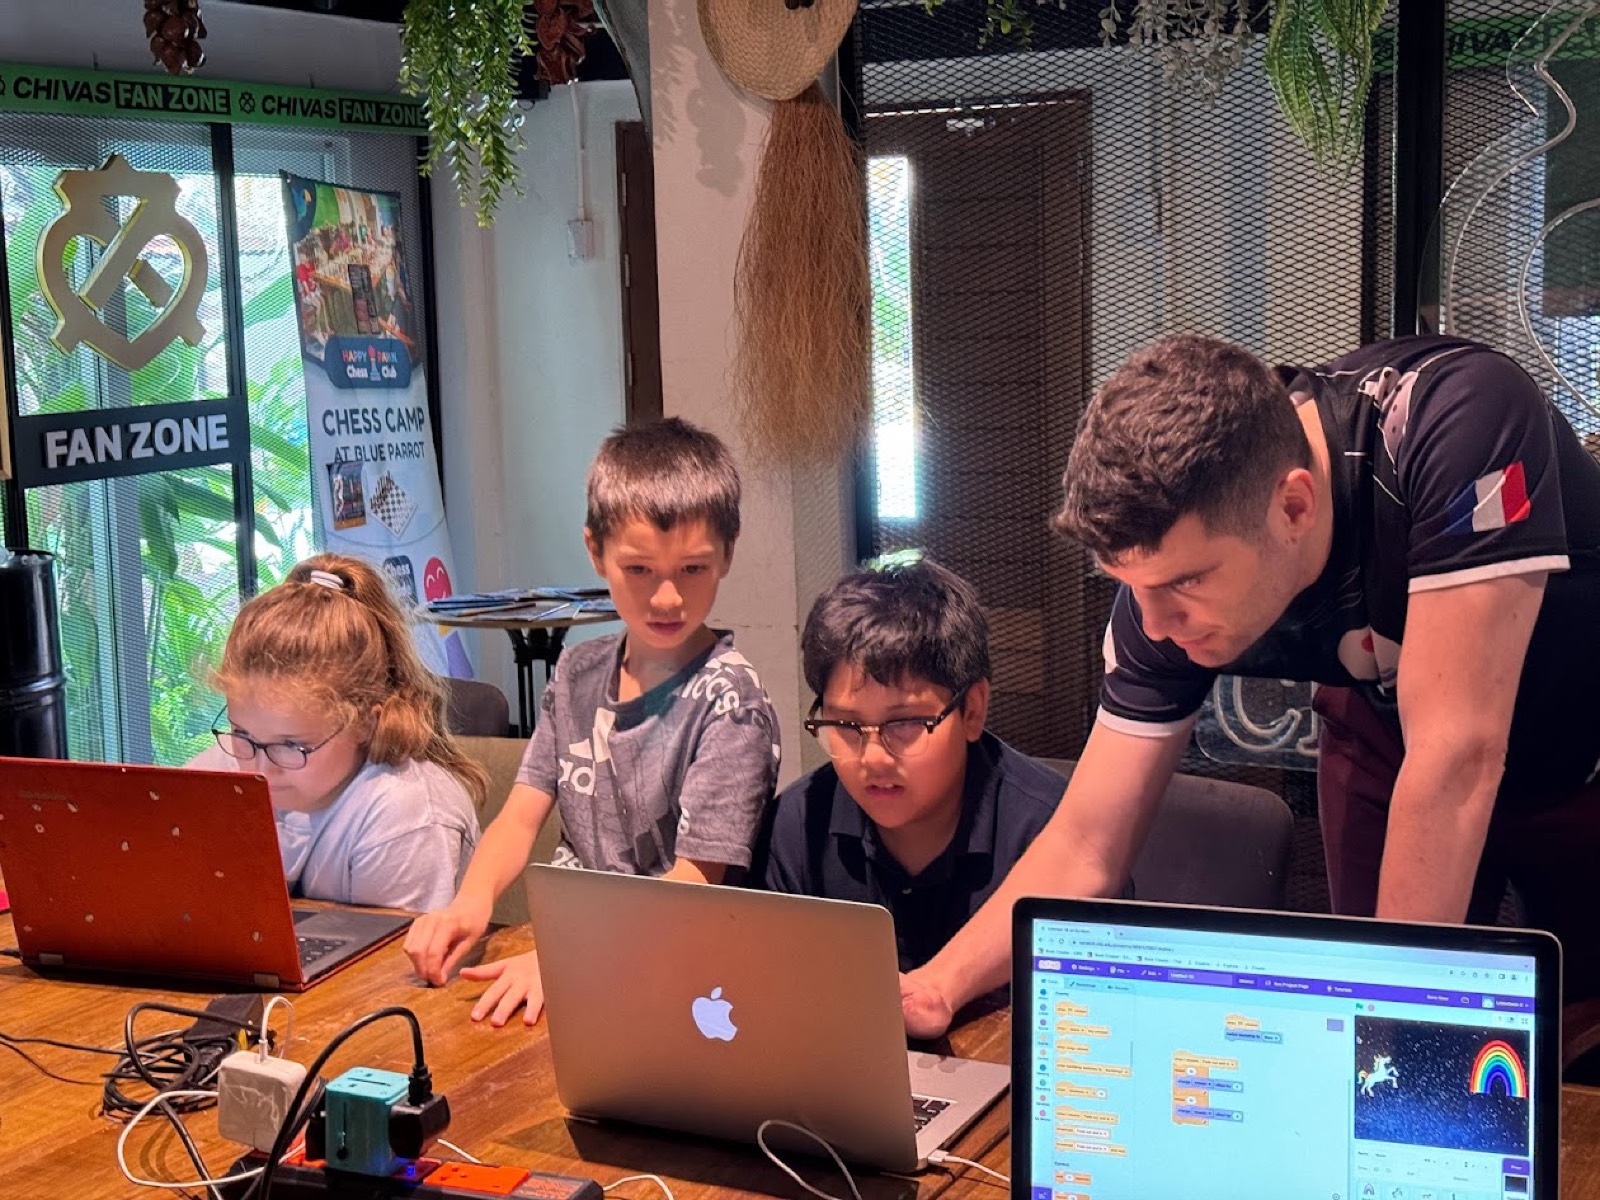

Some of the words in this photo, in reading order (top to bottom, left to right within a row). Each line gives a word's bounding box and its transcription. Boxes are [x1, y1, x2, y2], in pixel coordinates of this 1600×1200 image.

[13, 75, 112, 104] CHIVAS
[118, 83, 164, 109] FAN
[168, 86, 229, 113] ZONE
[261, 94, 336, 119] CHIVAS
[342, 101, 377, 123] FAN
[380, 104, 427, 127] ZONE
[342, 349, 367, 363] HAPPY
[322, 408, 382, 437] CHESS
[385, 407, 425, 433] CAMP
[45, 424, 123, 469] FAN
[129, 414, 230, 459] ZONE
[334, 446, 350, 463] AT
[354, 443, 387, 462] BLUE
[387, 441, 425, 461] PARROT
